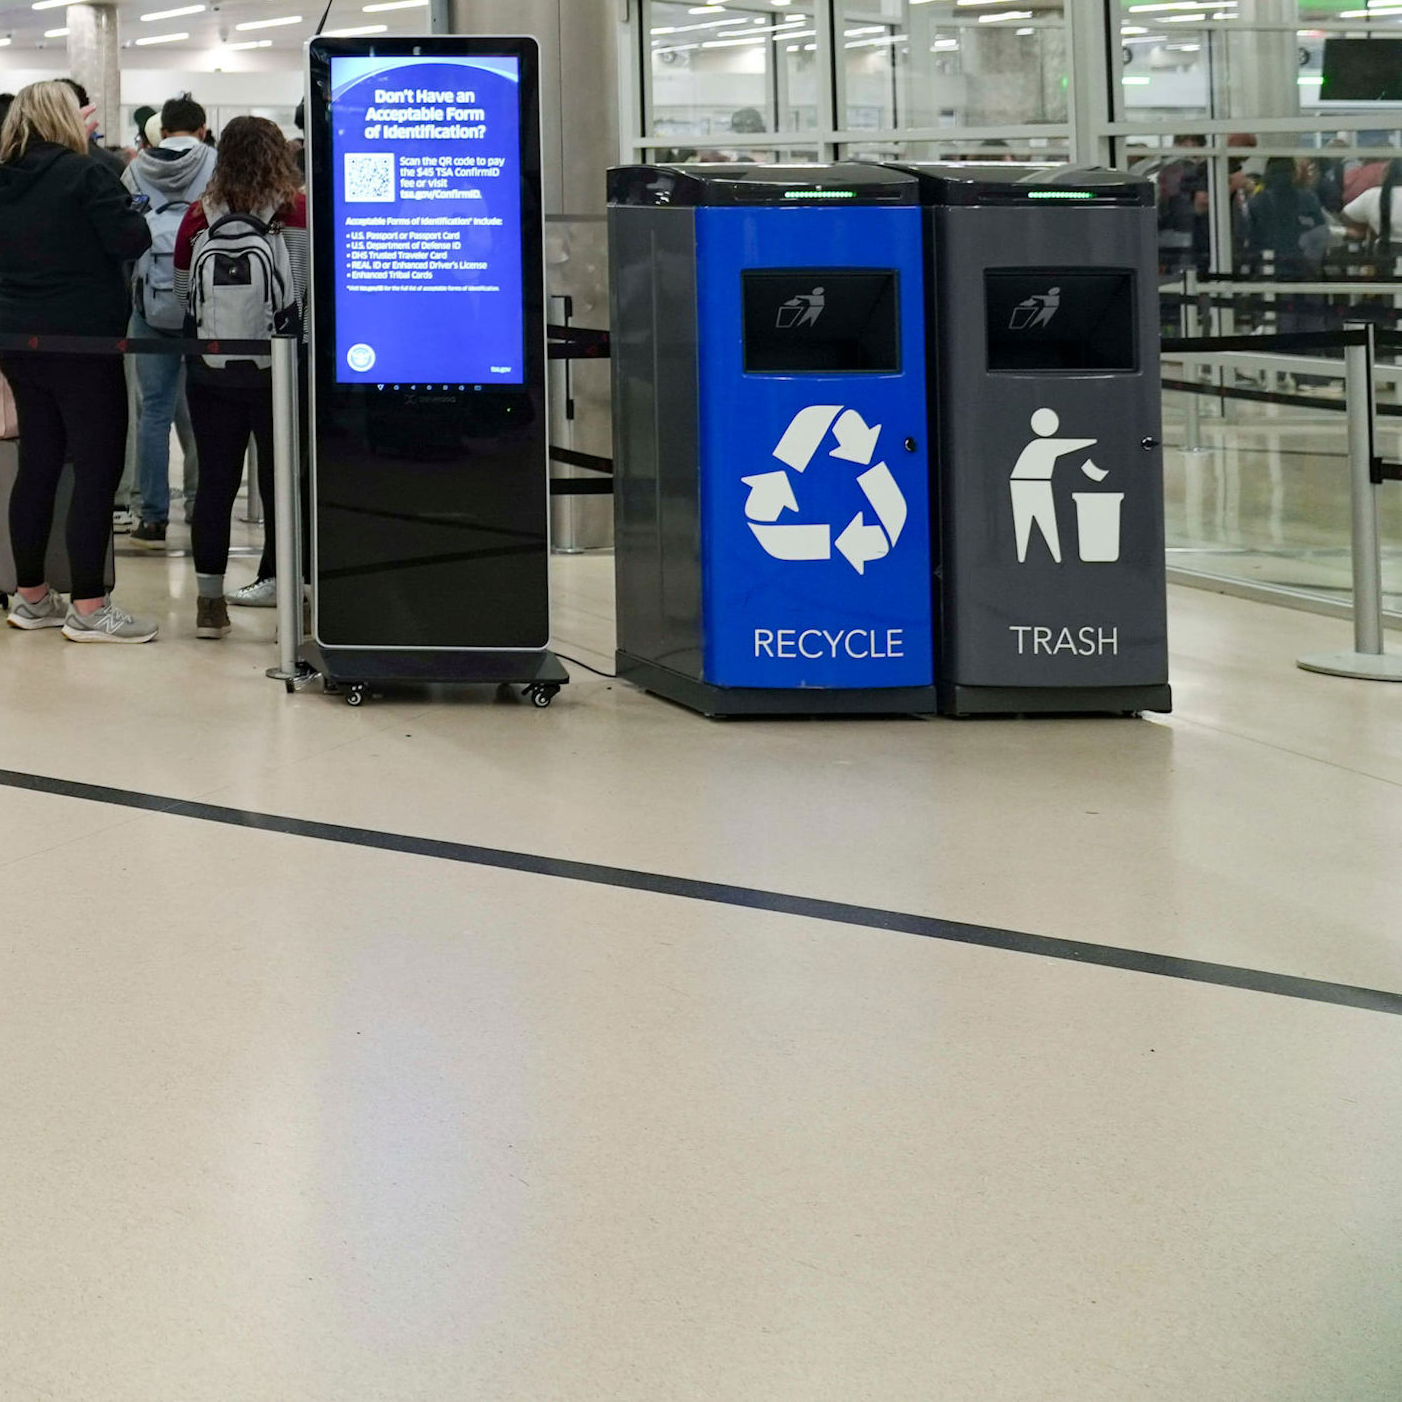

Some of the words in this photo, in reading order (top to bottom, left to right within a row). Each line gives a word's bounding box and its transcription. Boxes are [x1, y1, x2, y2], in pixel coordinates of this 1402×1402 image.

[375, 89, 414, 103] Don't
[416, 90, 454, 103] Have
[456, 92, 475, 102] an
[365, 107, 444, 123] Acceptable
[446, 107, 485, 121] Form
[365, 125, 381, 139] of
[384, 125, 486, 138] Identification?
[400, 157, 420, 166] Scan
[422, 157, 437, 165] the
[439, 157, 452, 167] QR
[454, 157, 475, 166] code
[476, 157, 486, 165] to
[488, 158, 505, 166] pay
[400, 168, 415, 177] the
[417, 167, 434, 177] $45
[436, 166, 453, 176] TSA
[455, 166, 501, 176] ConfirmID
[400, 179, 415, 187] fee
[428, 179, 447, 187] visit
[754, 628, 904, 659] RECYCLE
[1009, 626, 1118, 656] TRASH
